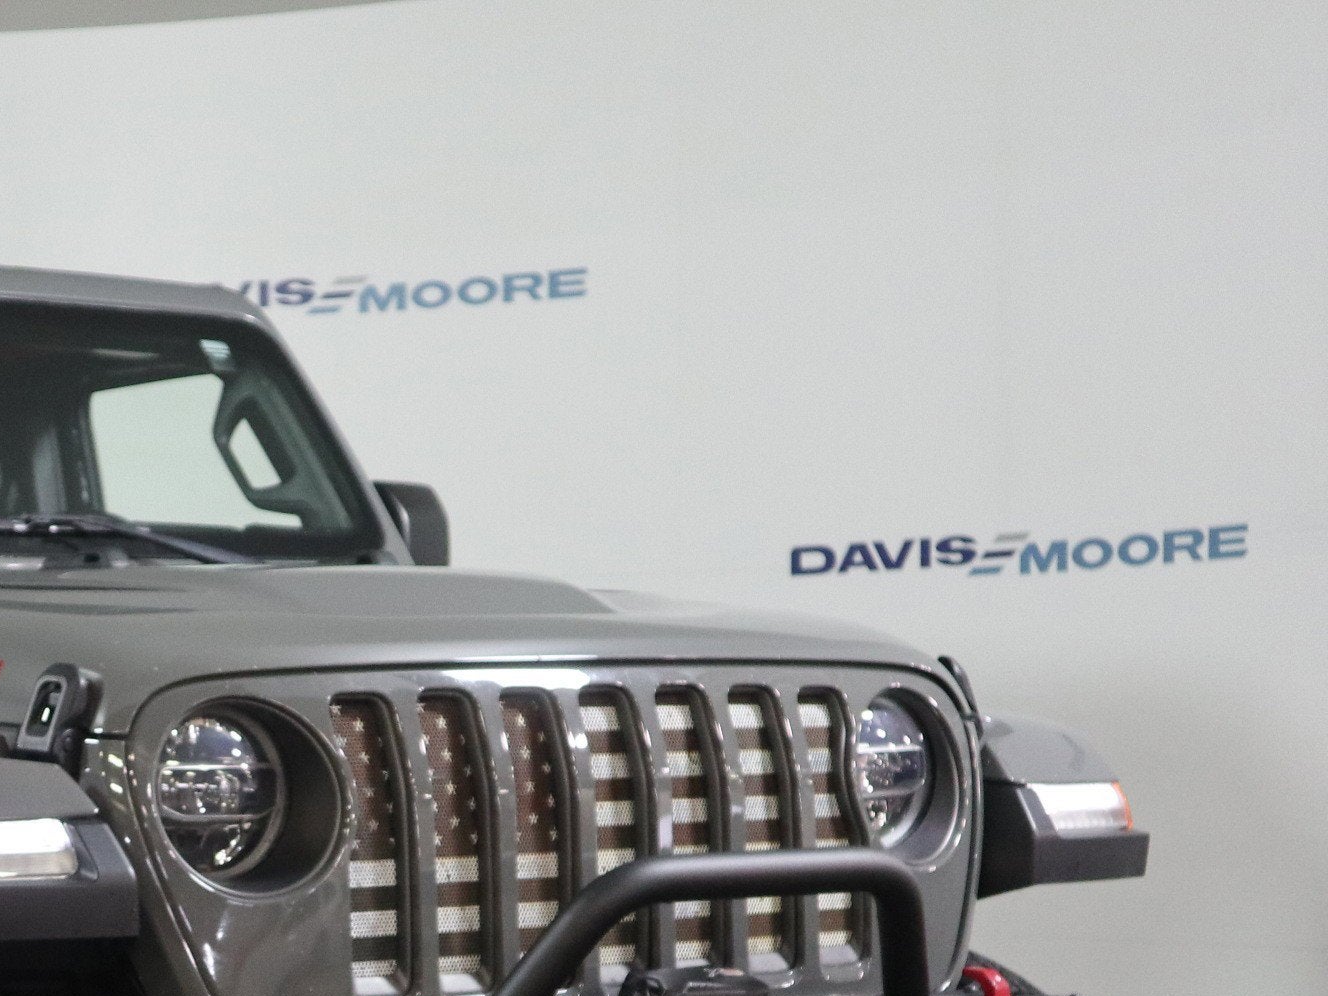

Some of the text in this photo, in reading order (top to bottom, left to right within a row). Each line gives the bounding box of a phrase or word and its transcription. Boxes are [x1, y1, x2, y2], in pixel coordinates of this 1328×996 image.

[358, 266, 589, 314] MOORE
[790, 523, 1249, 577] DAVIS MOORE
